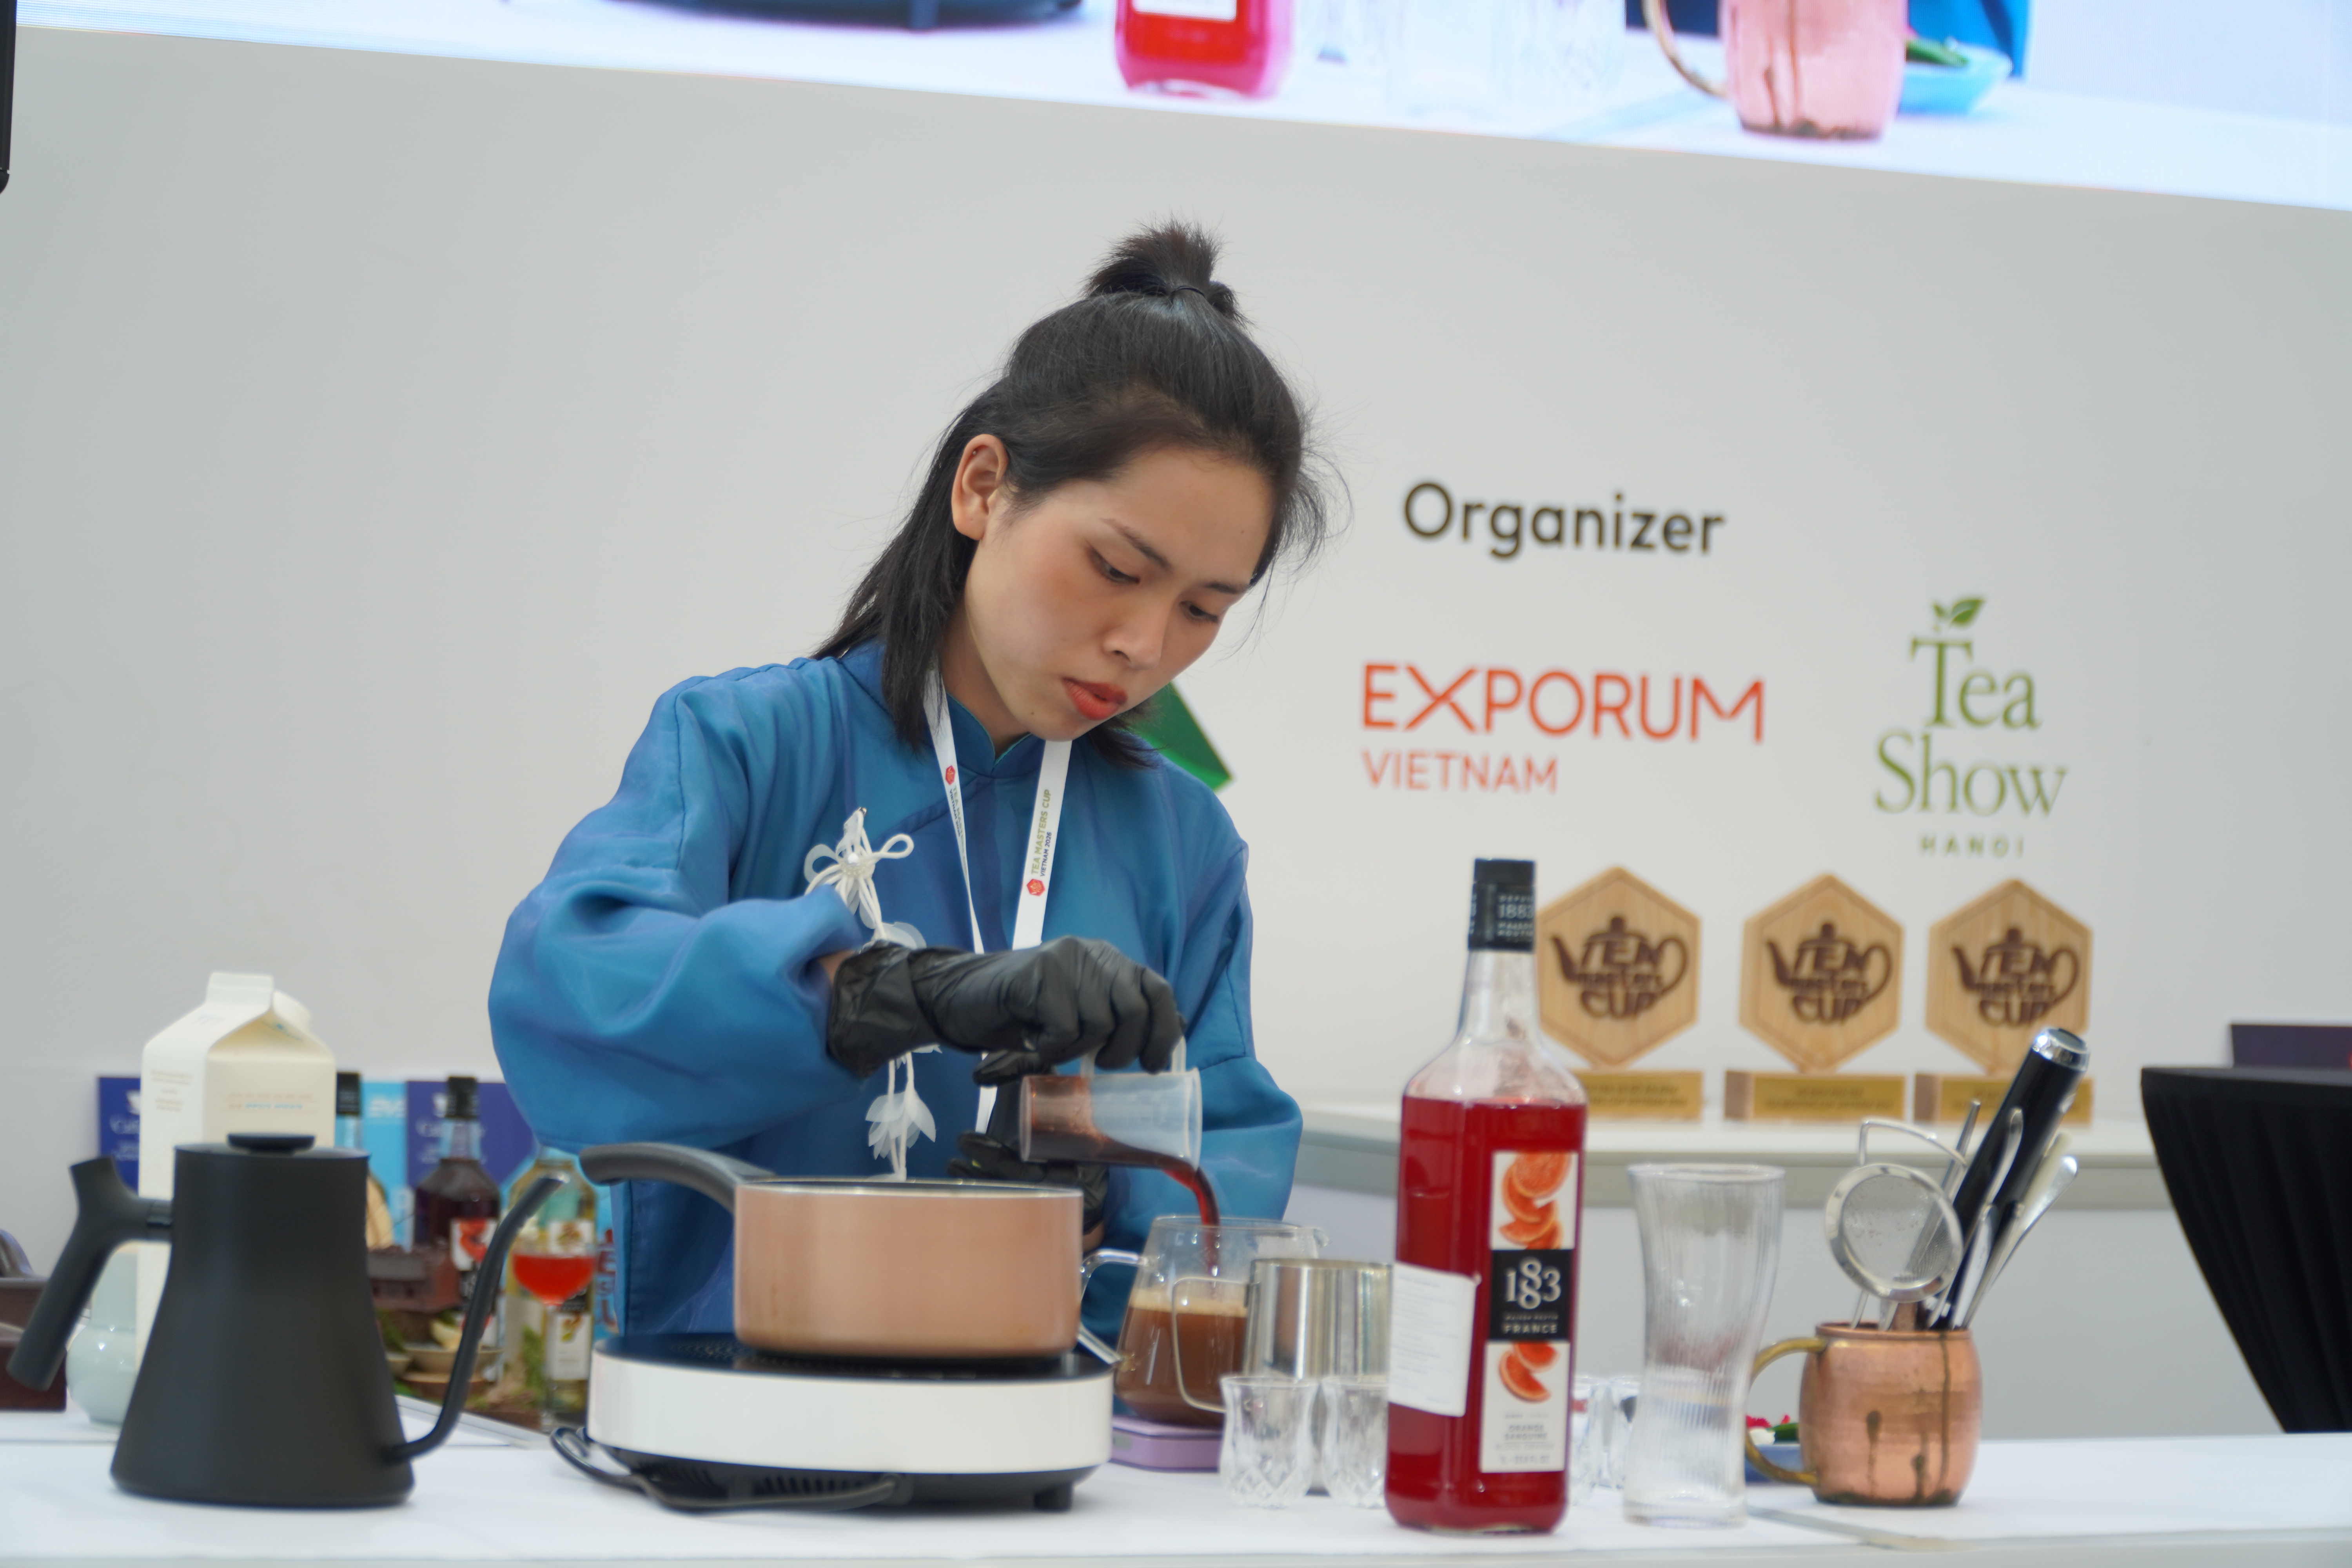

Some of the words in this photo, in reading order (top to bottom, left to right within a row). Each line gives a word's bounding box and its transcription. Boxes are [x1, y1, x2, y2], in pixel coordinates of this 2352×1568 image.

[1404, 481, 1726, 560] Organizer
[1363, 662, 1766, 745] EXPORUM
[1909, 637, 2042, 730] Tea
[1362, 749, 1559, 793] VIETNAM
[1875, 728, 2069, 818] Show
[1042, 789, 1051, 808] CUP
[1034, 811, 1048, 855] MASTERS
[1921, 835, 2024, 858] HANOI
[1031, 857, 1041, 875] TEA
[1040, 849, 1049, 877] VIETNAM
[1502, 1322, 1558, 1333] FRANCE
